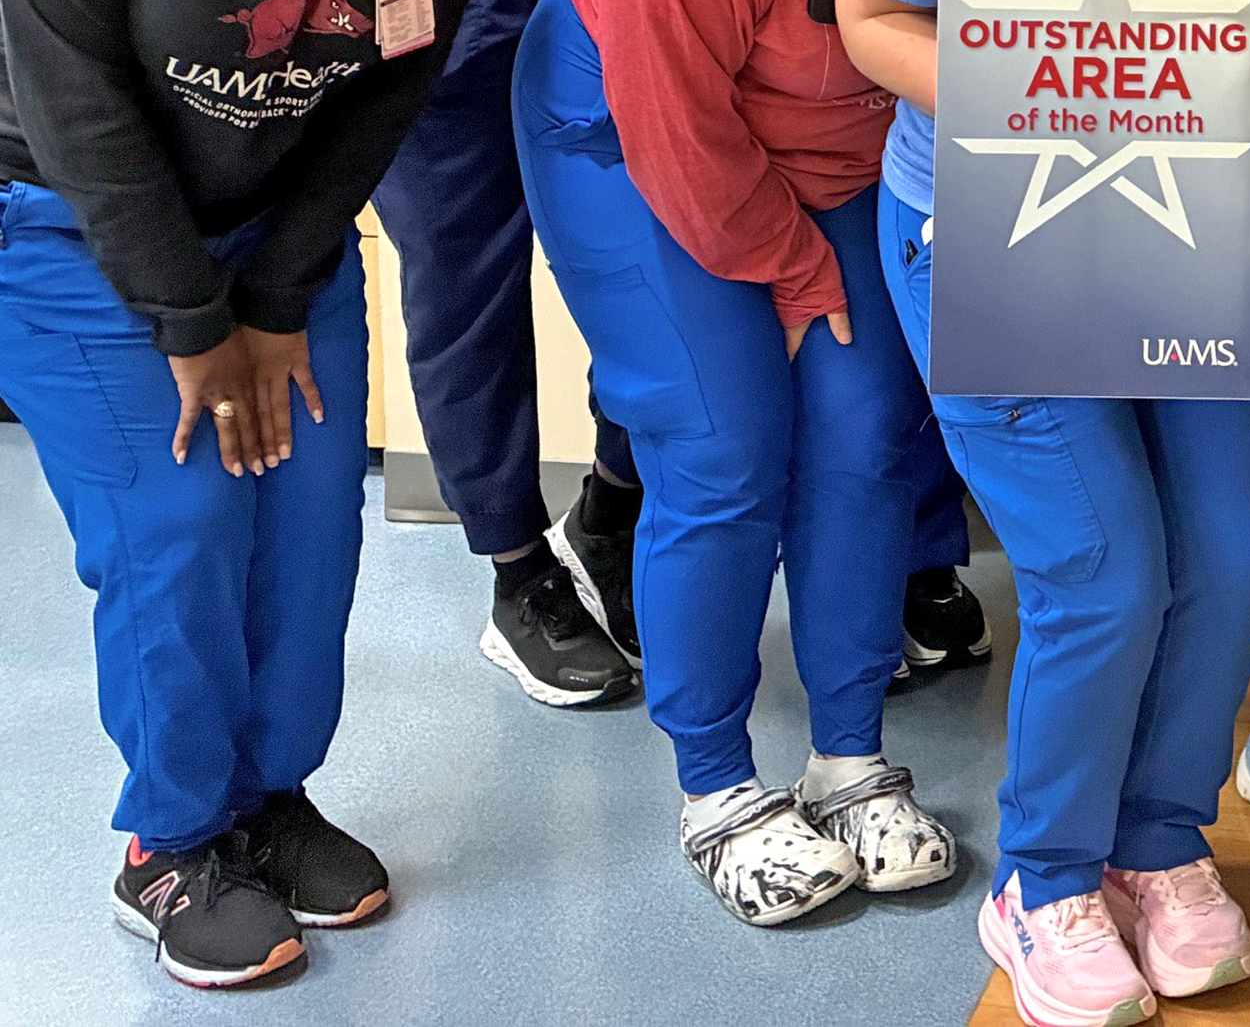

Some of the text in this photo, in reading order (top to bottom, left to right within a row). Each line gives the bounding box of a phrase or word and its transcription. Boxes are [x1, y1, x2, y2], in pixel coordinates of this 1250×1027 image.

[959, 19, 1248, 52] OUTSTANDING
[1025, 56, 1192, 100] AREA
[1007, 107, 1204, 134] of the Month
[1142, 338, 1238, 367] UAMS
